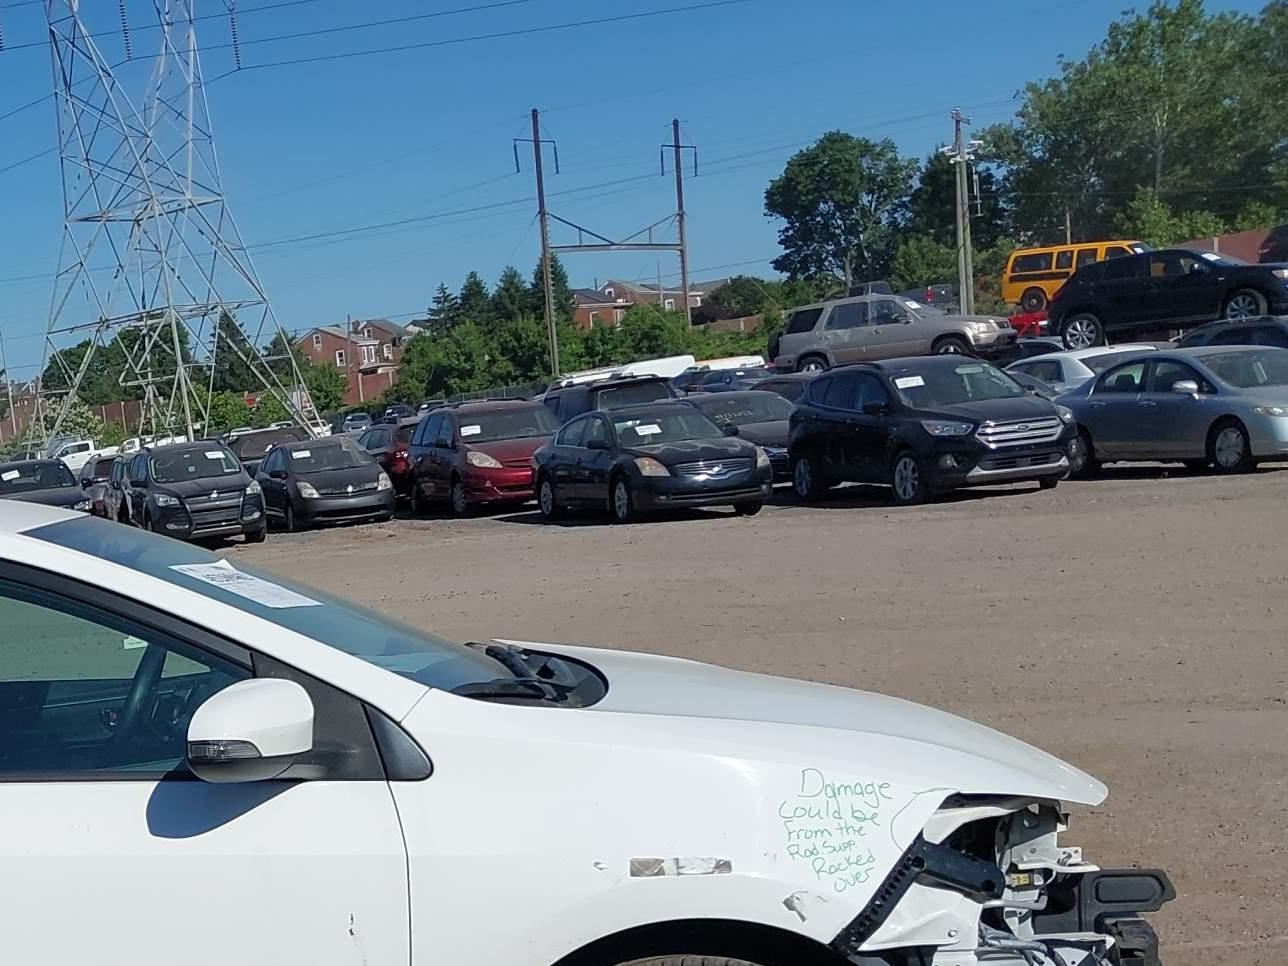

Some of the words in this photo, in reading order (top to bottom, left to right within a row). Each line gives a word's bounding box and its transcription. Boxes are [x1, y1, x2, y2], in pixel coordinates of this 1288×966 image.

[797, 768, 894, 808] Damage
[850, 803, 881, 827] be
[835, 820, 867, 837] the
